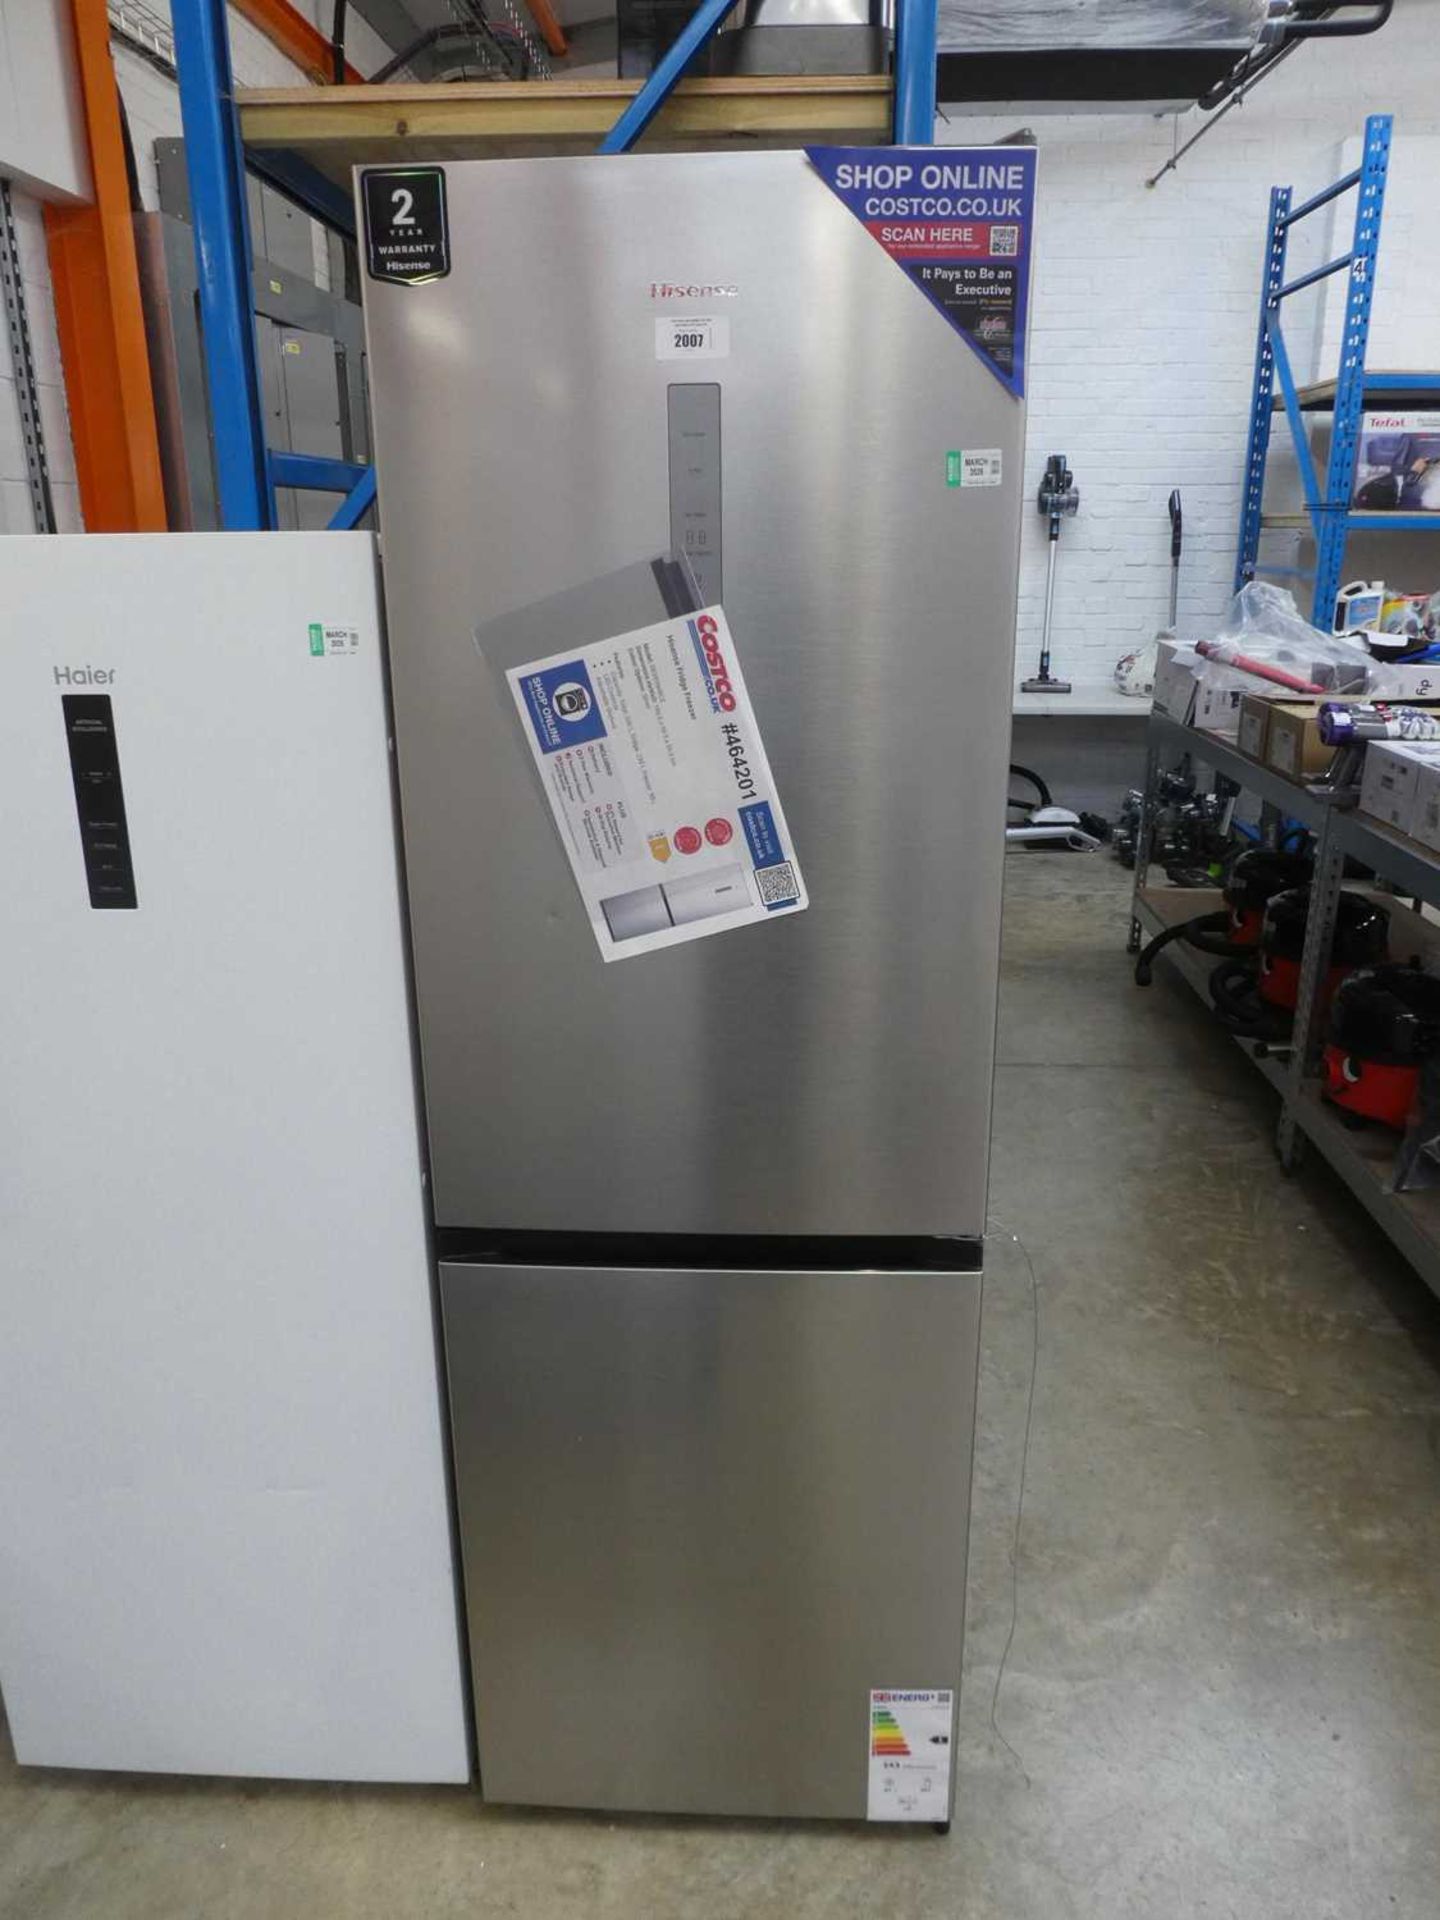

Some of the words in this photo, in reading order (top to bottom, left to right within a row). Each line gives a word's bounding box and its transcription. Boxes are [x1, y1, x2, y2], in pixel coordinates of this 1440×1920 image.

[835, 164, 913, 189] SHOP
[920, 165, 1024, 190] ONLINE
[391, 188, 415, 225] 2
[865, 197, 1022, 216] COSTCO.CO.UK
[389, 228, 423, 236] YEAR
[881, 227, 925, 242] SCAN
[929, 227, 973, 242] HERE
[378, 244, 436, 255] WARRANTY
[386, 261, 431, 272] Hisense
[922, 267, 932, 279] It
[934, 267, 961, 282] Pays
[964, 268, 977, 279] to
[979, 267, 995, 279] Be
[997, 269, 1013, 279] an
[651, 282, 738, 299] Hisense
[955, 283, 1013, 295] Executive
[674, 333, 704, 348] 2007
[1370, 417, 1404, 427] Tefal
[697, 614, 737, 713] COSTCO
[53, 665, 116, 685] Haier
[703, 680, 722, 714] CO.UK
[531, 676, 548, 706] SHOP
[540, 705, 562, 746] ONLINE
[721, 722, 757, 800] #464201
